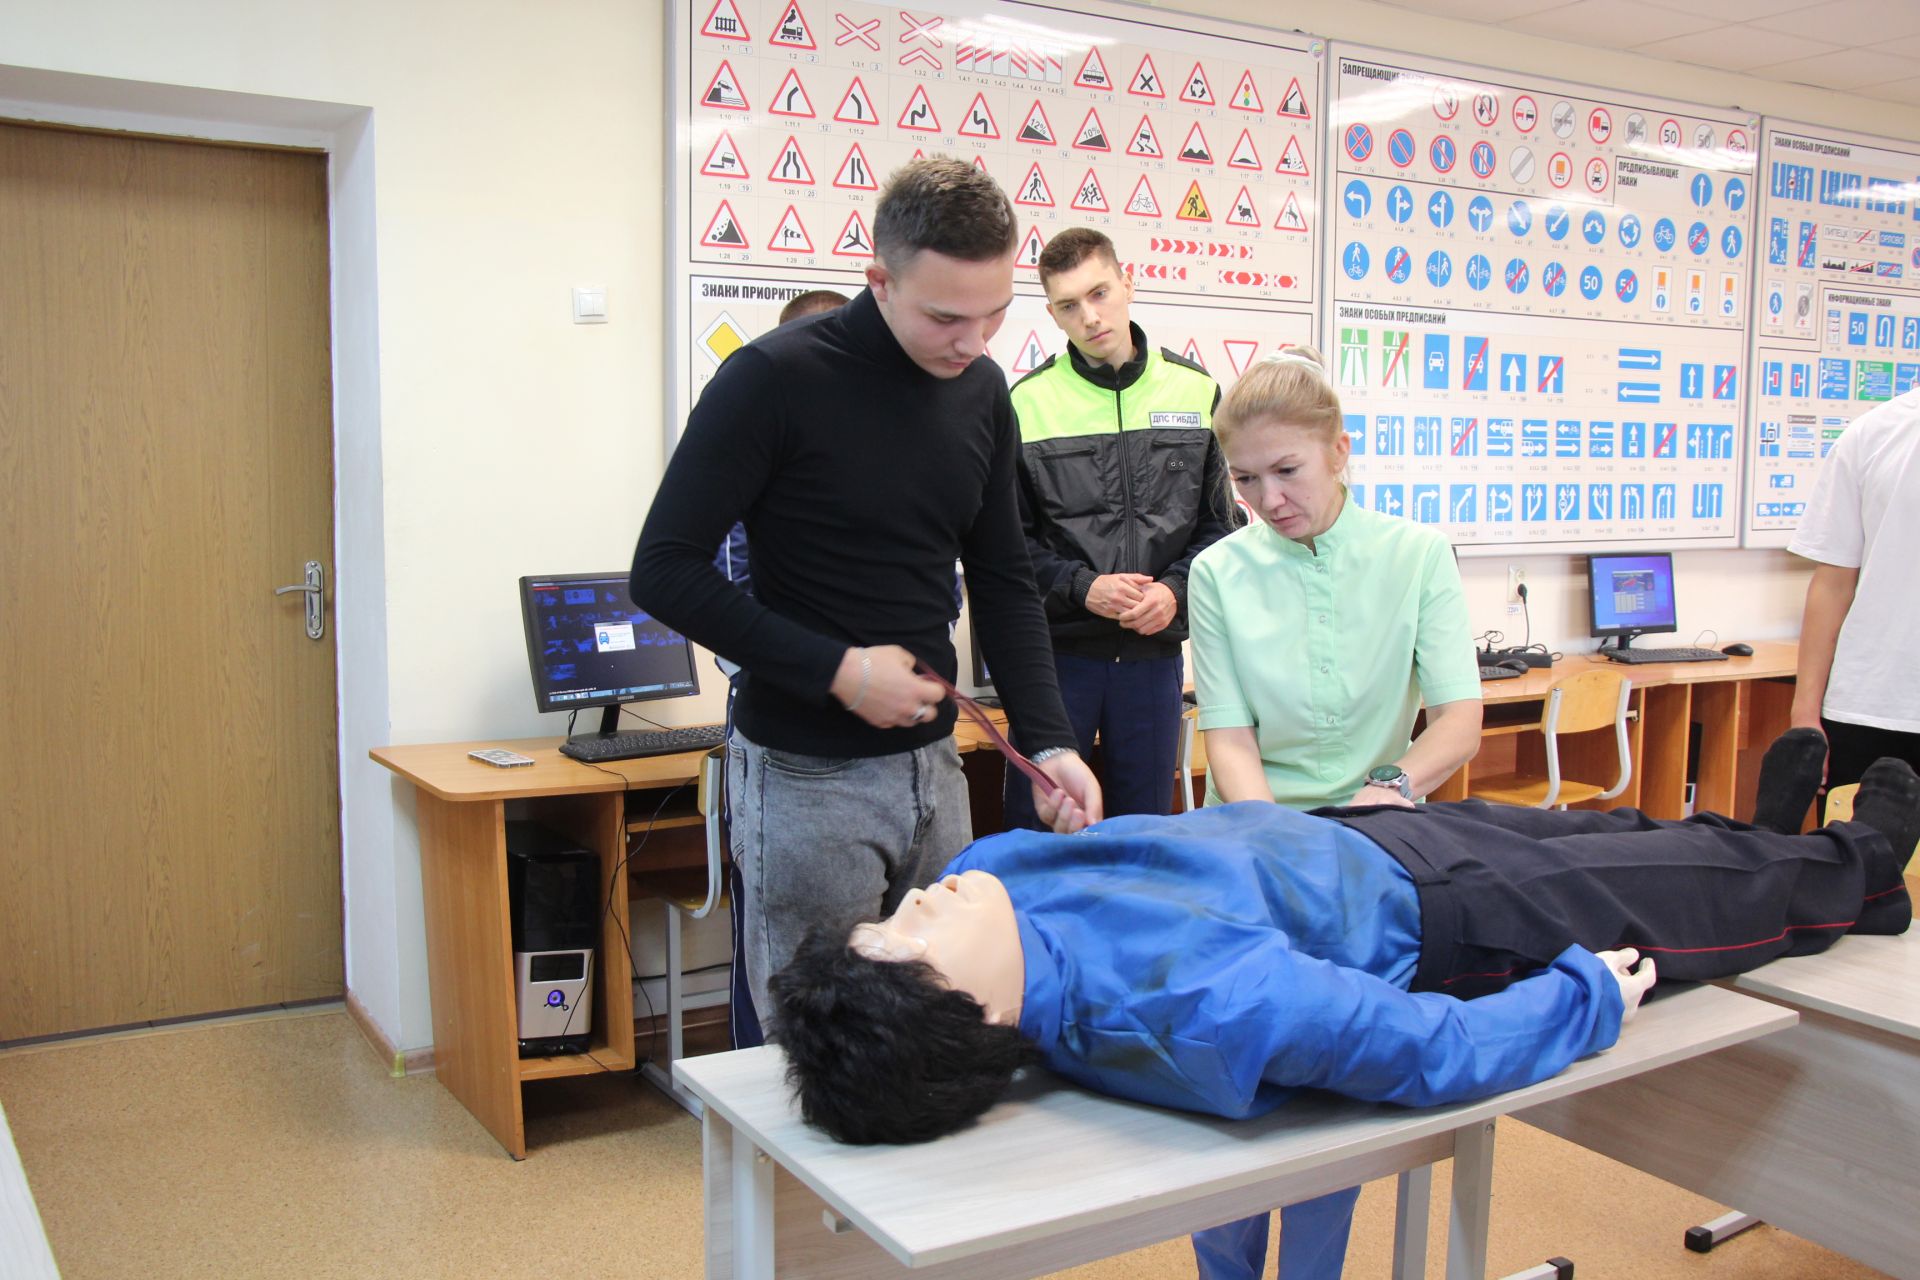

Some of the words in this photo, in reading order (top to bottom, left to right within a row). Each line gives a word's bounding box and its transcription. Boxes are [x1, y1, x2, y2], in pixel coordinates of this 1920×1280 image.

[914, 69, 927, 77] 1.3.2
[1342, 63, 1400, 81] ЗАПРЕЩАЮЩИЕ
[785, 120, 800, 128] 1.11.1
[1030, 118, 1048, 135] 12%
[1083, 126, 1100, 139] 10%
[1663, 129, 1677, 144] 50
[1698, 134, 1711, 149] 50
[1618, 161, 1679, 179] ПРЕДПИСЫВАЮЩИЕ
[1617, 175, 1638, 187] ЗНАКИ
[784, 188, 800, 196] 1.20.1
[1583, 275, 1599, 290] 50
[702, 283, 739, 298] ЗНАКИ
[1339, 306, 1363, 319] ЗНАКИ
[1364, 308, 1395, 321] ОСОБЫХ
[1396, 310, 1446, 325] ПРЕДПИСАНИЙ
[1851, 321, 1865, 335] 50
[1153, 414, 1170, 424] ДПС
[1171, 415, 1199, 425] ГИБДД
